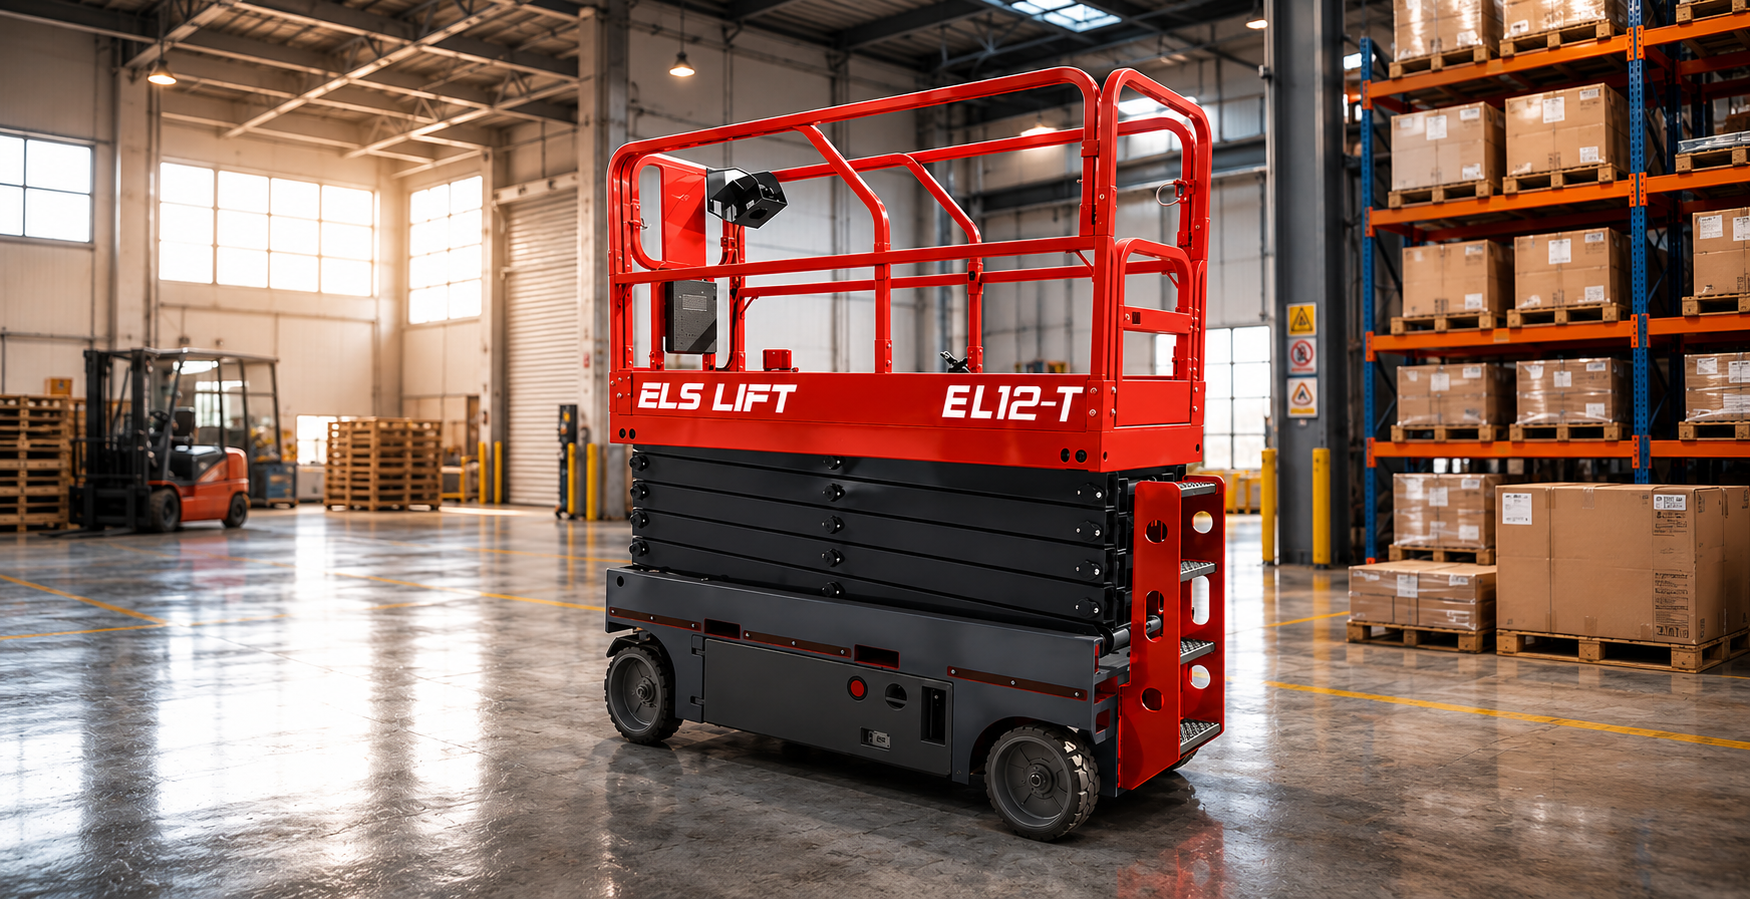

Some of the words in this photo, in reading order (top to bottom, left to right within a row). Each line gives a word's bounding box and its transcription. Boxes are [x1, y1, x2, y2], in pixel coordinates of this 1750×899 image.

[638, 382, 704, 410] ELS
[712, 383, 797, 413] LIFT
[942, 385, 1084, 422] EL12-T
